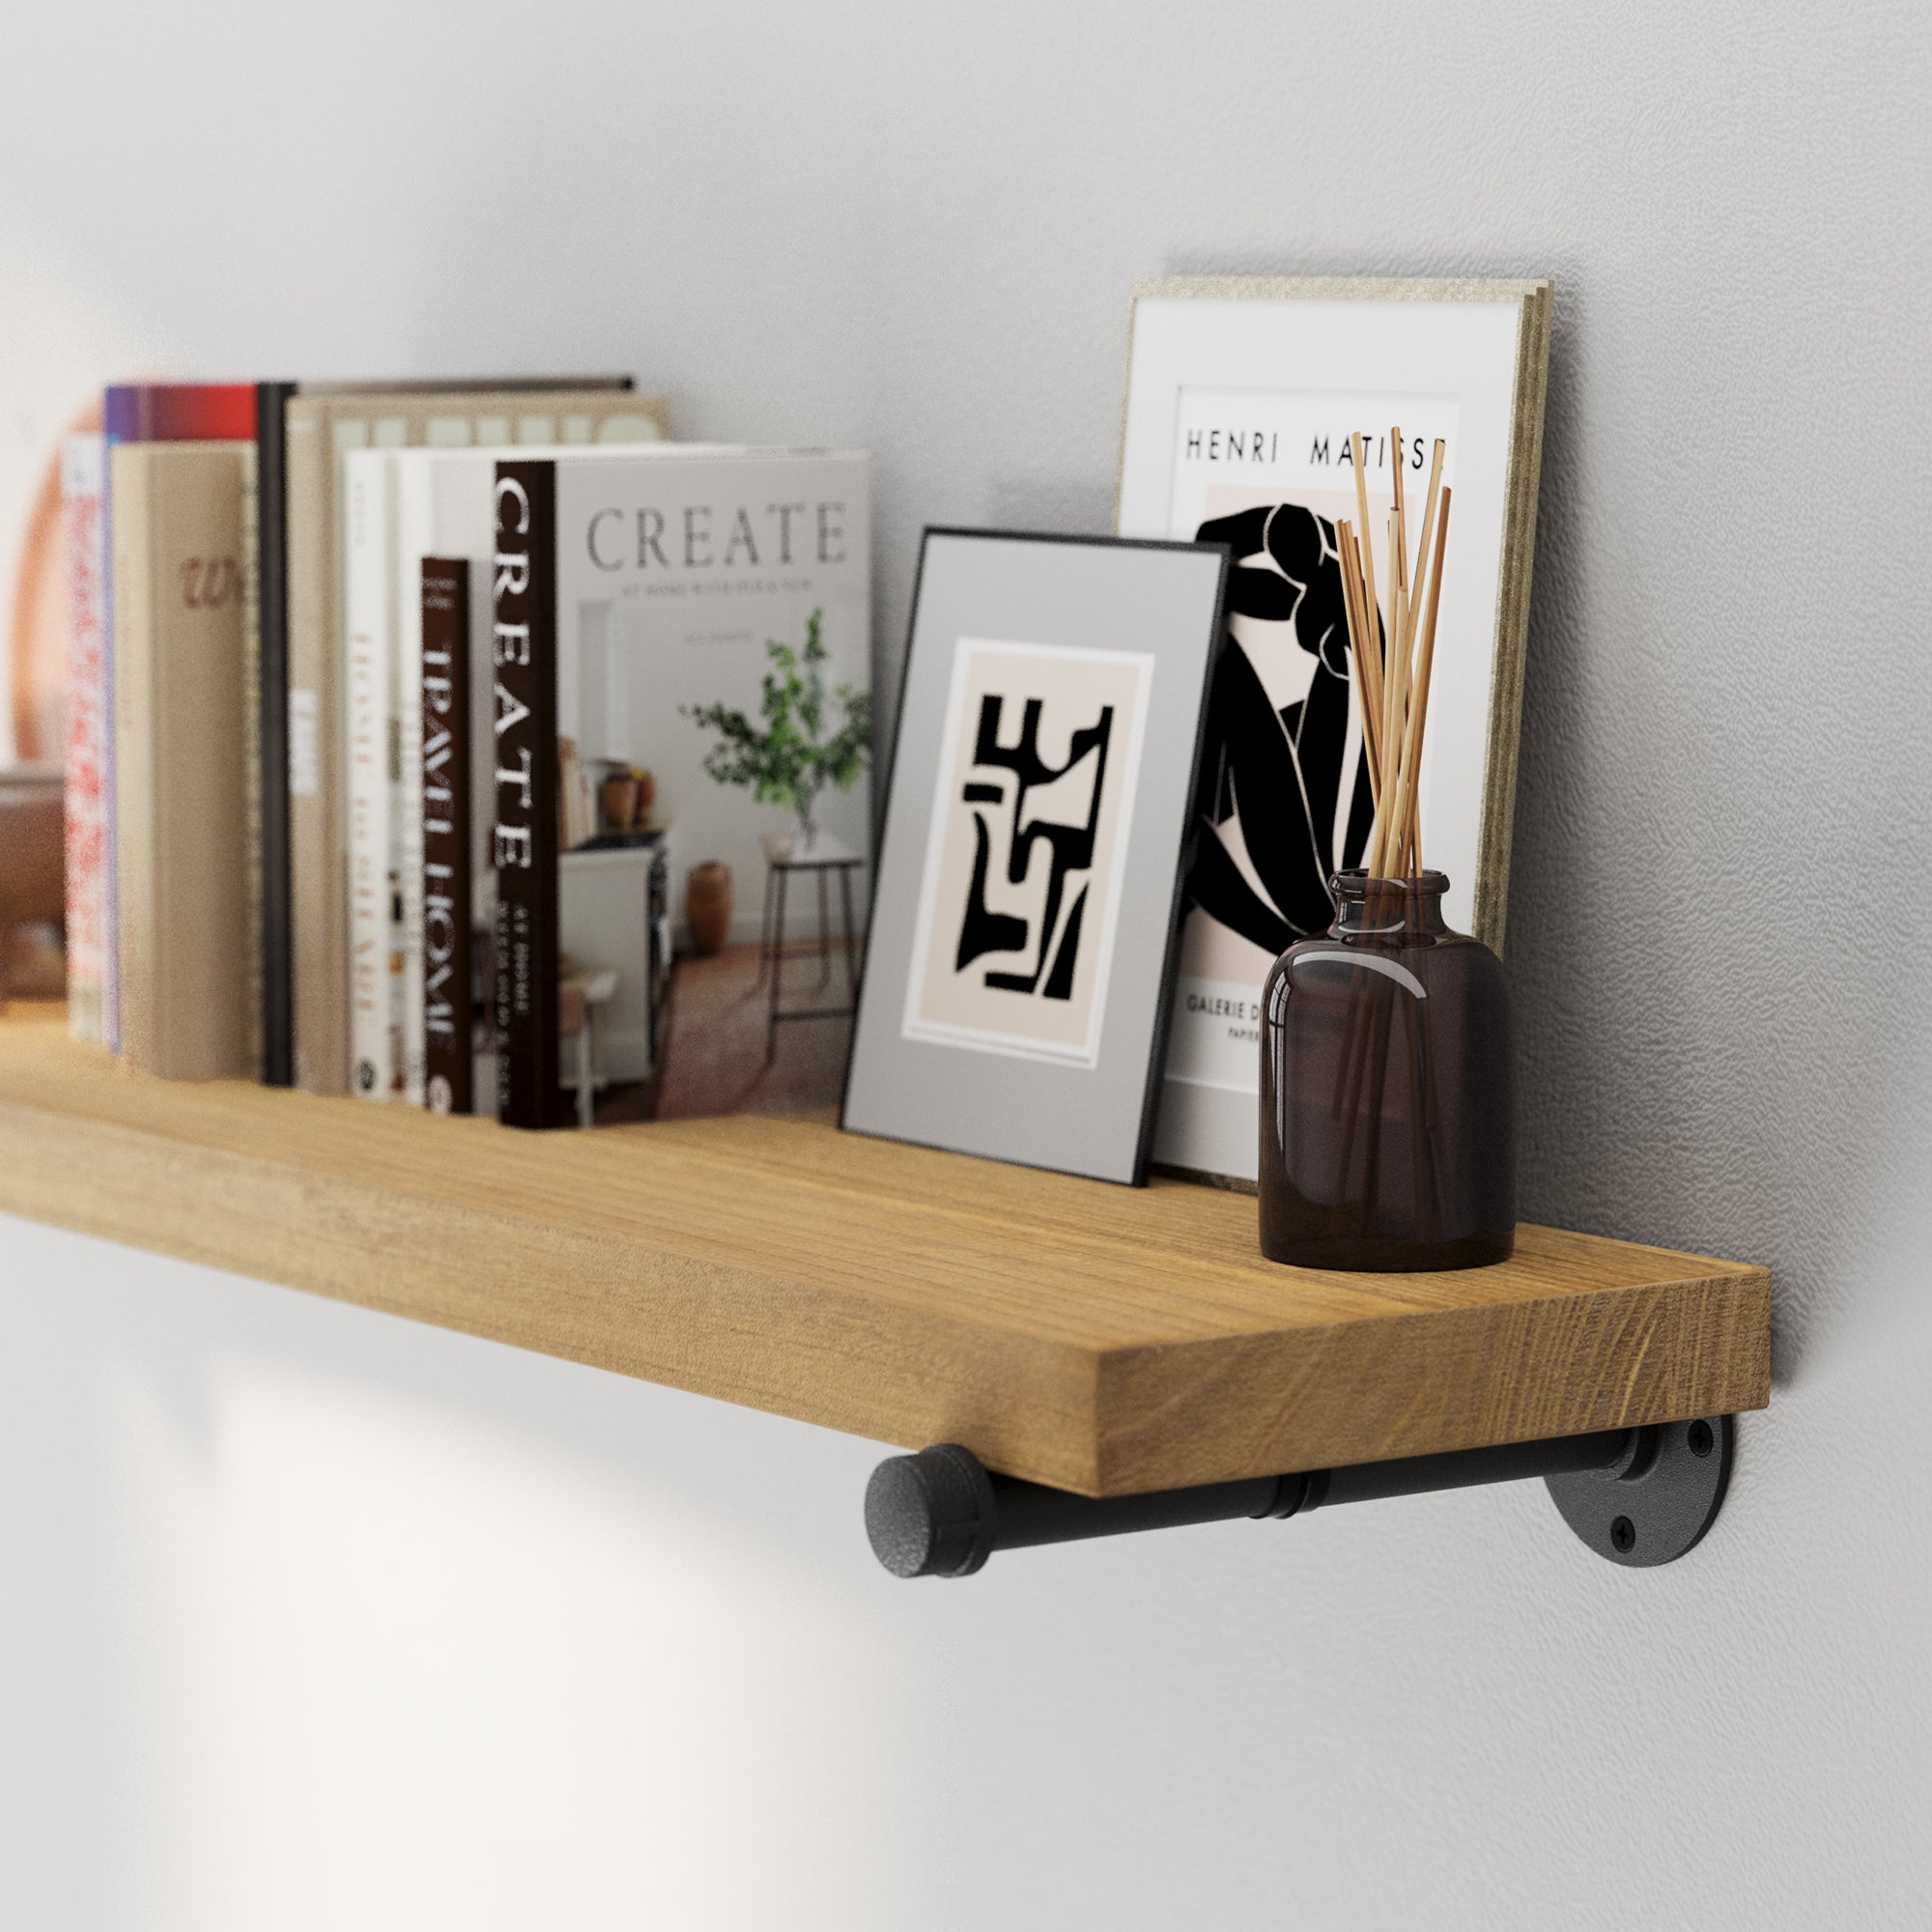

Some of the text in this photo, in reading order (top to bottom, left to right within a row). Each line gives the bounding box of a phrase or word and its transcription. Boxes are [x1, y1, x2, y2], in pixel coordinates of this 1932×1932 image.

[1185, 430, 1445, 470] HENRI MATIS
[585, 501, 849, 573] CREATE
[494, 476, 533, 868] CREATE
[1186, 993, 1245, 1020] GALERIE
